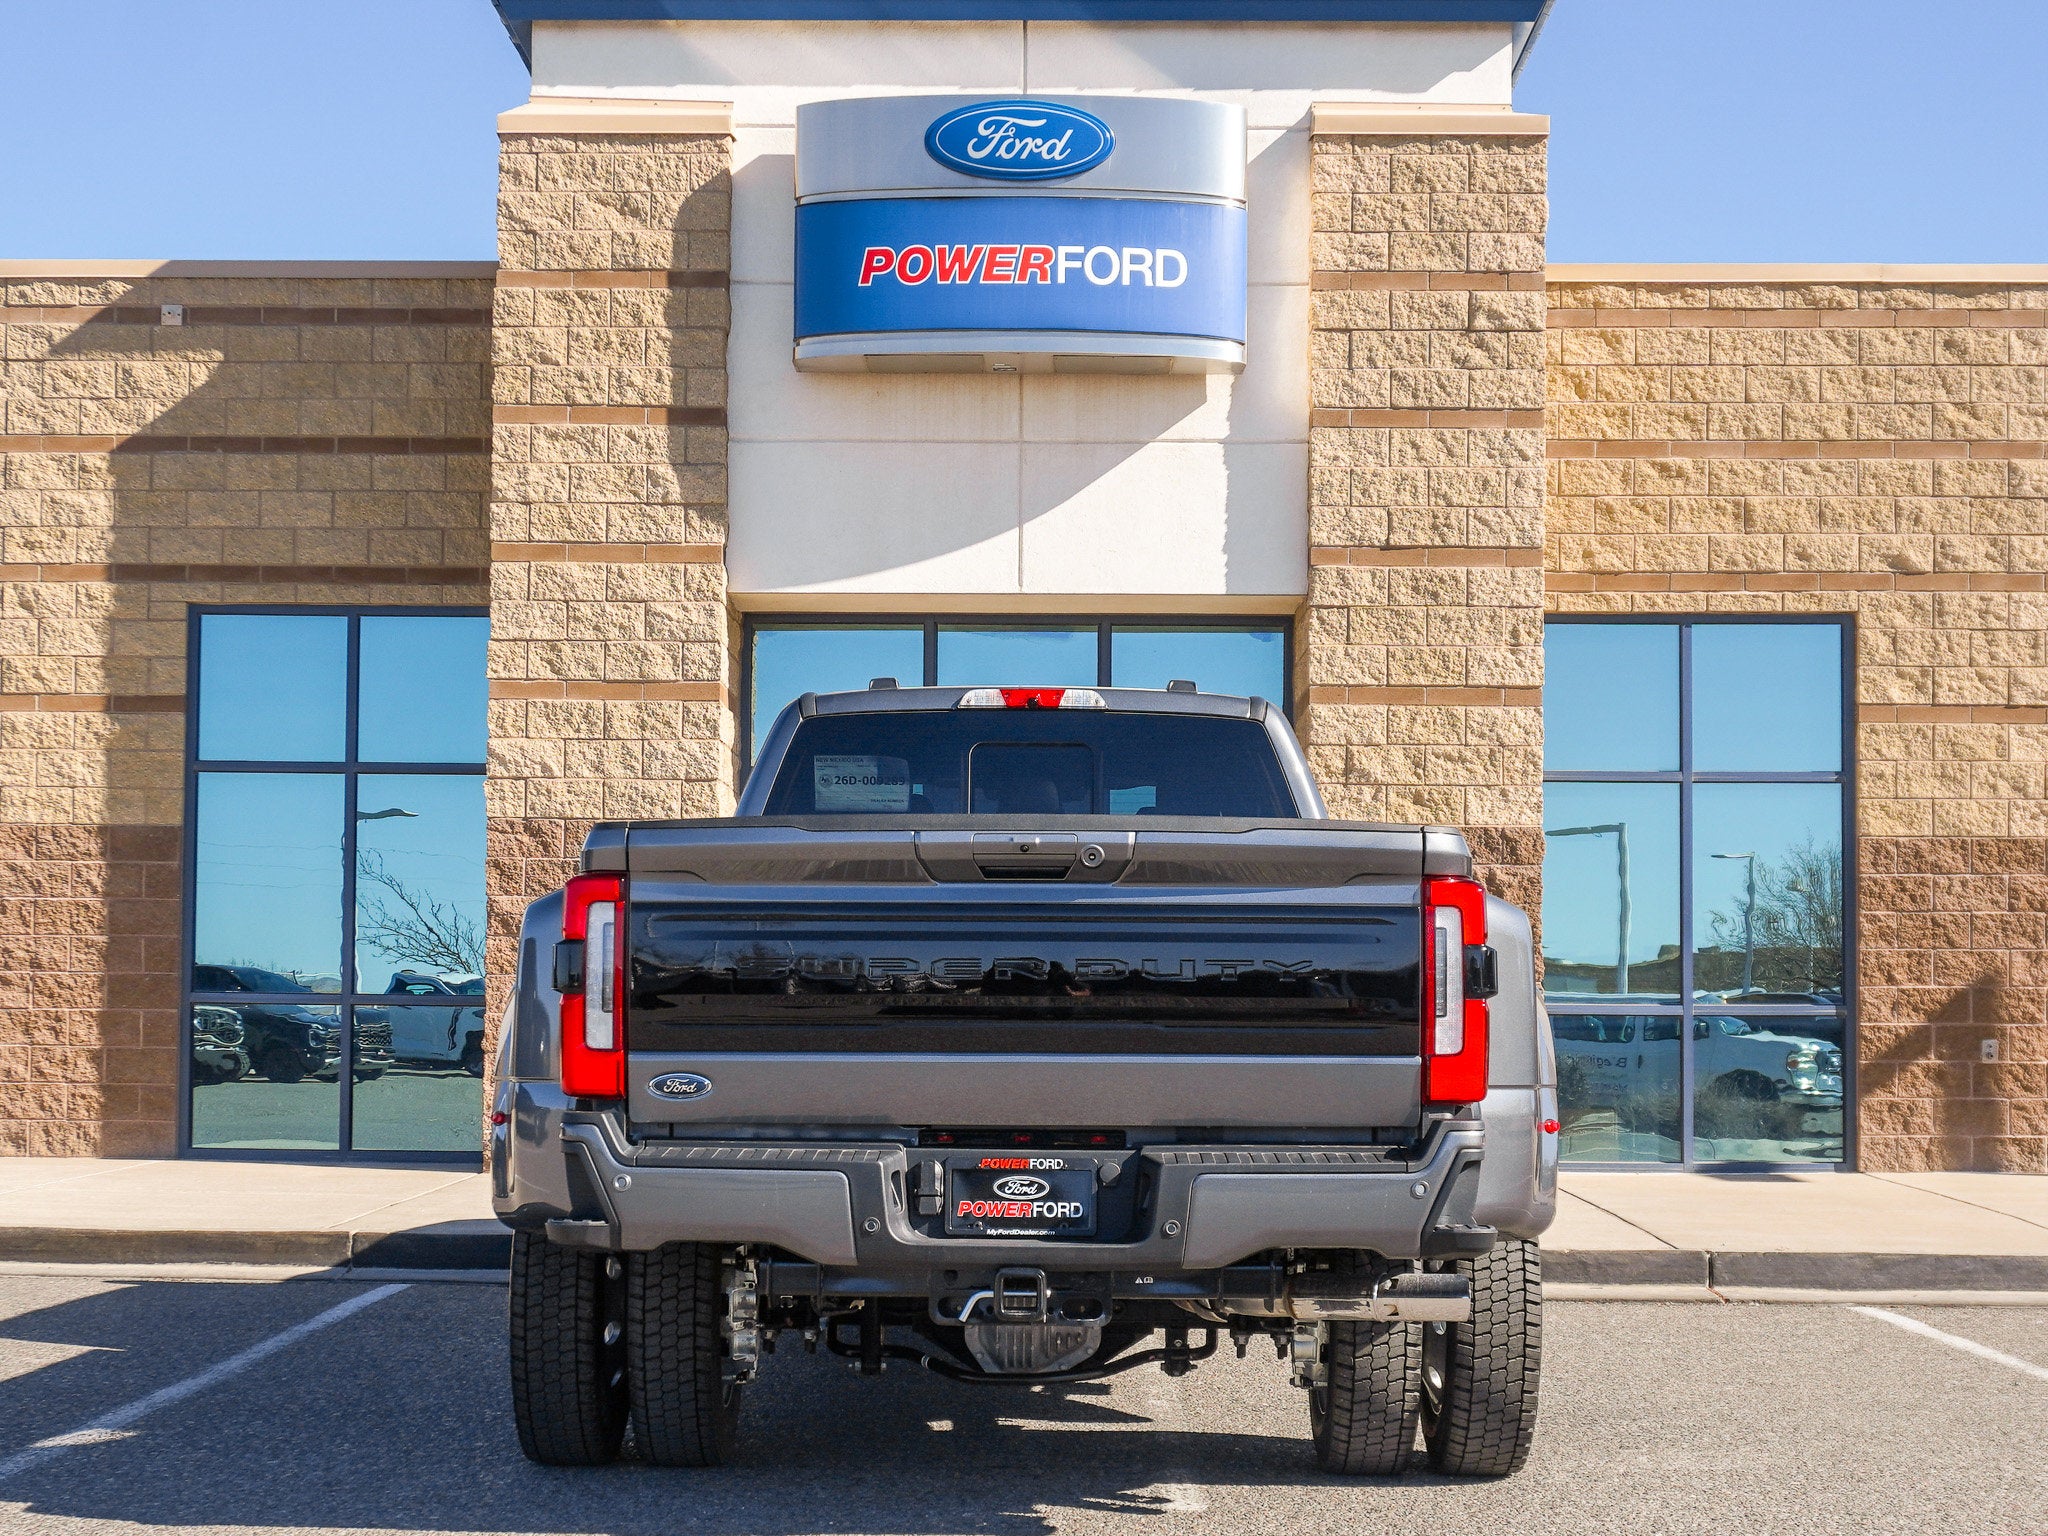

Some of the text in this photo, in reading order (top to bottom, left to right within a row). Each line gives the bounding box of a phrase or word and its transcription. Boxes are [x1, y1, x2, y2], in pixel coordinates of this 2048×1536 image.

[966, 116, 1072, 162] Ford
[857, 243, 1189, 288] POWERFORD
[738, 957, 1313, 982] SUPER DUTY
[663, 1078, 697, 1093] Ford
[980, 1158, 1064, 1170] POWERFORD
[1004, 1180, 1039, 1195] Ford
[957, 1201, 1084, 1218] POWERFORD
[986, 1228, 1056, 1236] MyFordDealer.com
